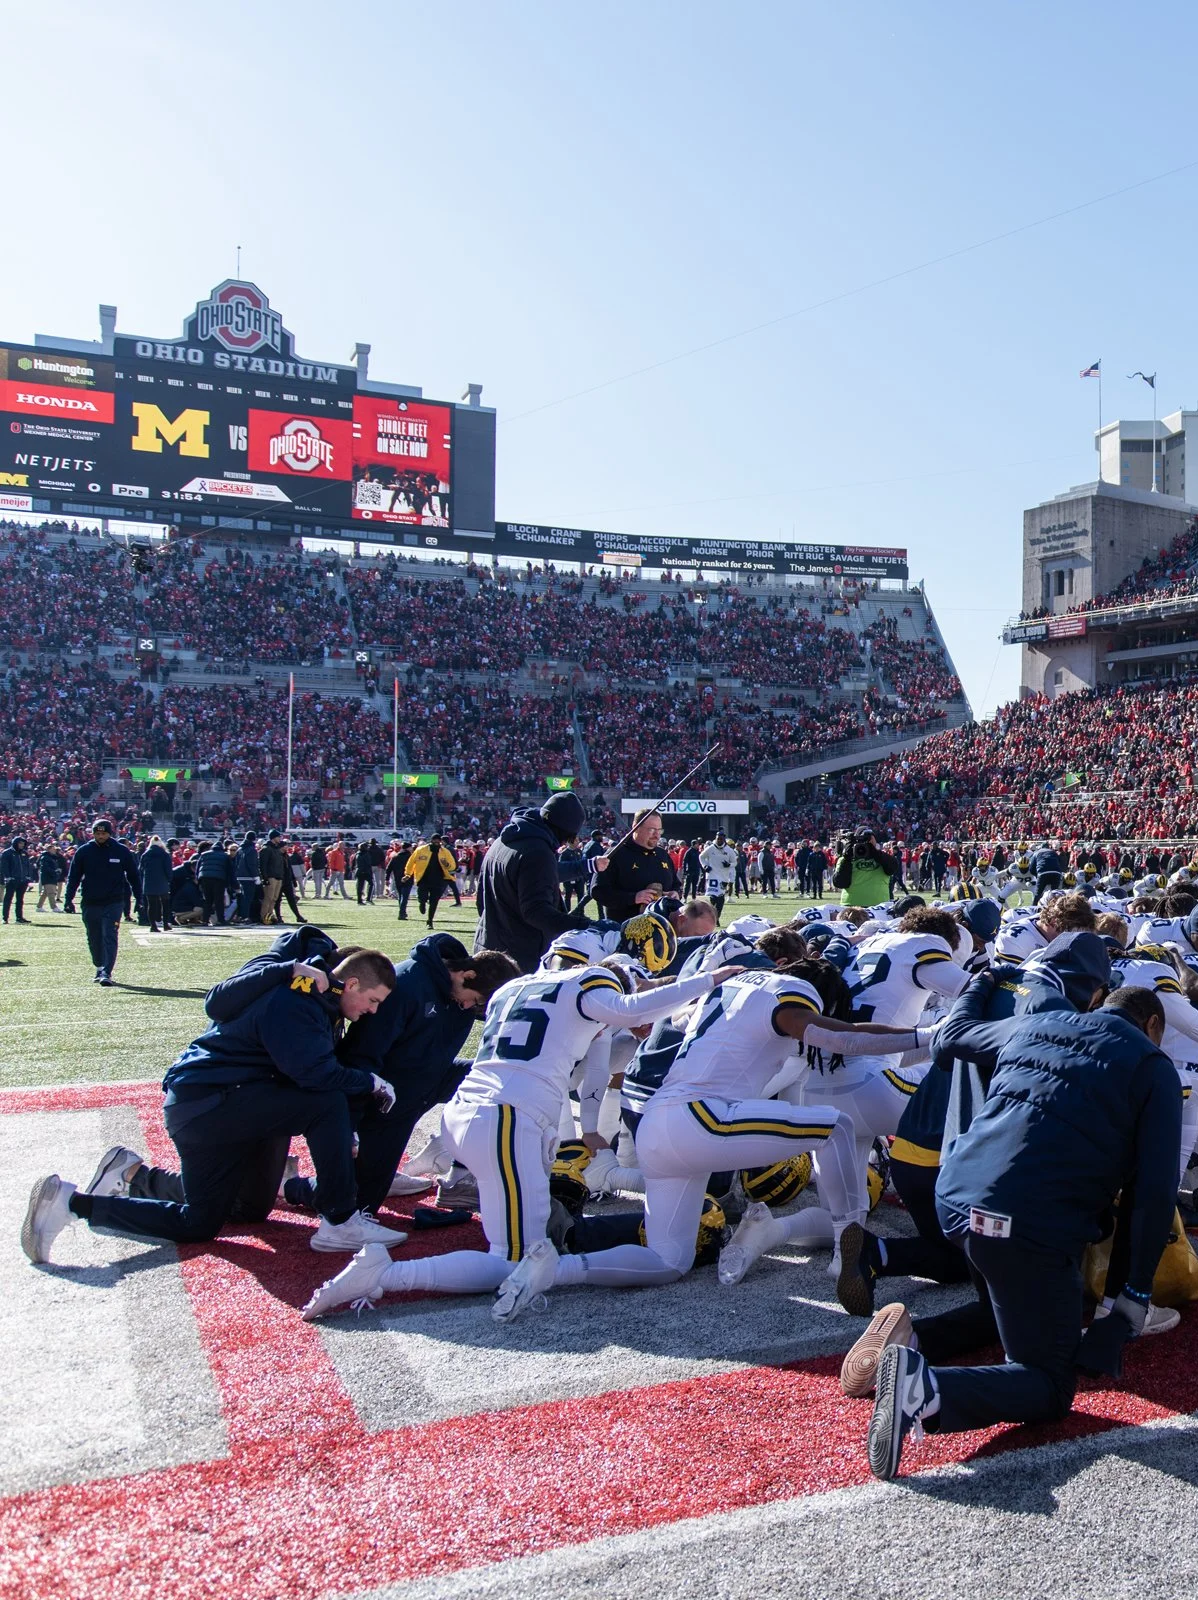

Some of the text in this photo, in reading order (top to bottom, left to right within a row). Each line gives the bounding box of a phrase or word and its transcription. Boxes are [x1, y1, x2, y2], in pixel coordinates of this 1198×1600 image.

[198, 301, 281, 351] OHIO STATE
[33, 358, 94, 377] Huntington
[135, 341, 338, 384] OHIO STADIUM
[16, 393, 99, 411] HONDA
[132, 402, 210, 459] M
[378, 418, 428, 438] SINGLE MEET
[229, 424, 247, 451] VS
[382, 432, 425, 442] TICKETS
[269, 432, 334, 472] OHIO STATE
[377, 437, 428, 458] ON SALE NOW
[15, 453, 94, 471] NETJETS
[38, 479, 75, 487] MICHIGAN
[208, 481, 253, 492] BUCKEYES
[118, 487, 143, 496] Pre
[161, 490, 203, 502] 31:54
[0, 498, 29, 507] meijer
[507, 524, 538, 535] BLOCH
[550, 528, 582, 539] CRANE
[593, 532, 628, 543] PHIPPS
[700, 540, 759, 550] HUNTINGTON
[762, 542, 787, 551] BANK
[794, 544, 836, 553] WEBSTER
[515, 533, 907, 565] SCHUMAKER O'SHAUGHNESSY NOURSE PRIOR RITE RUG SAVAGE NETJETS
[845, 546, 855, 554] Pay
[662, 557, 700, 567] Nationally
[702, 559, 729, 568] ranked
[730, 560, 742, 568] for
[789, 563, 805, 572] The
[807, 564, 833, 573] James
[140, 639, 153, 650] 25
[356, 651, 368, 661] 25
[657, 801, 717, 813] encova
